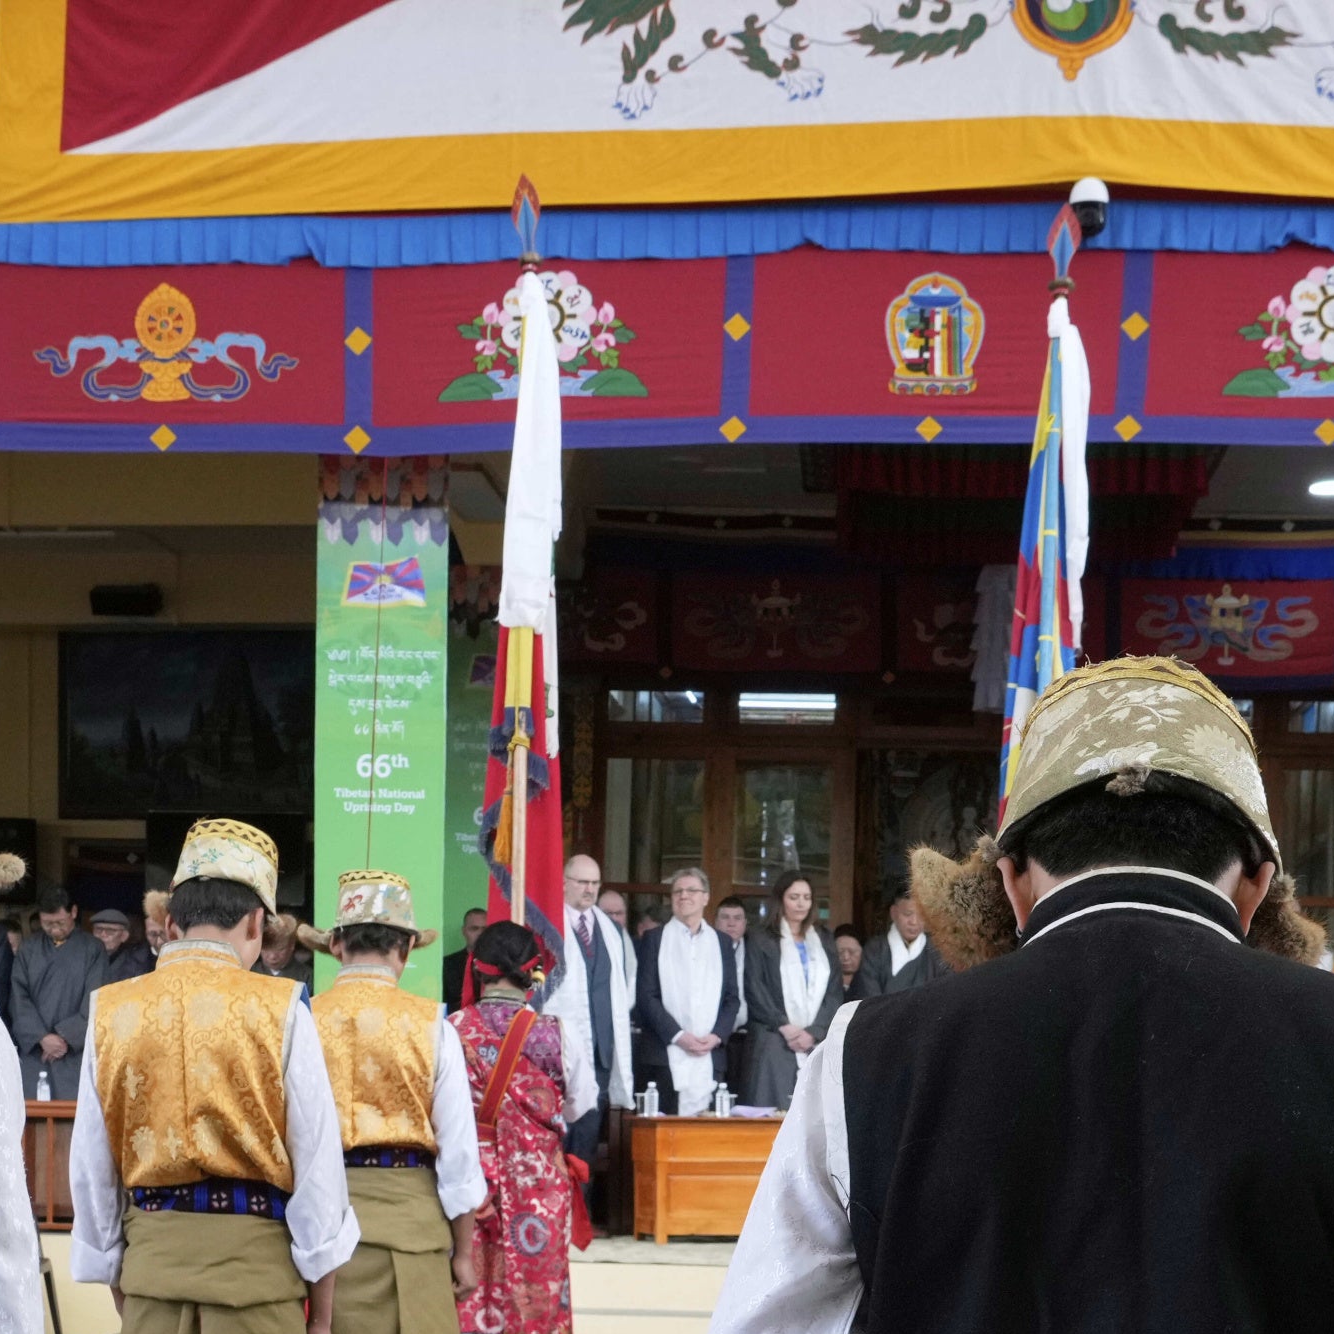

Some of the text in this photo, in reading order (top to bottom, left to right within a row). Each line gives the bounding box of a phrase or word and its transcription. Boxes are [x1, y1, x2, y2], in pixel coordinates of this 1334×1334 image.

[355, 752, 411, 778] 66th
[333, 787, 426, 799] Tibetan National
[394, 802, 416, 815] Day
